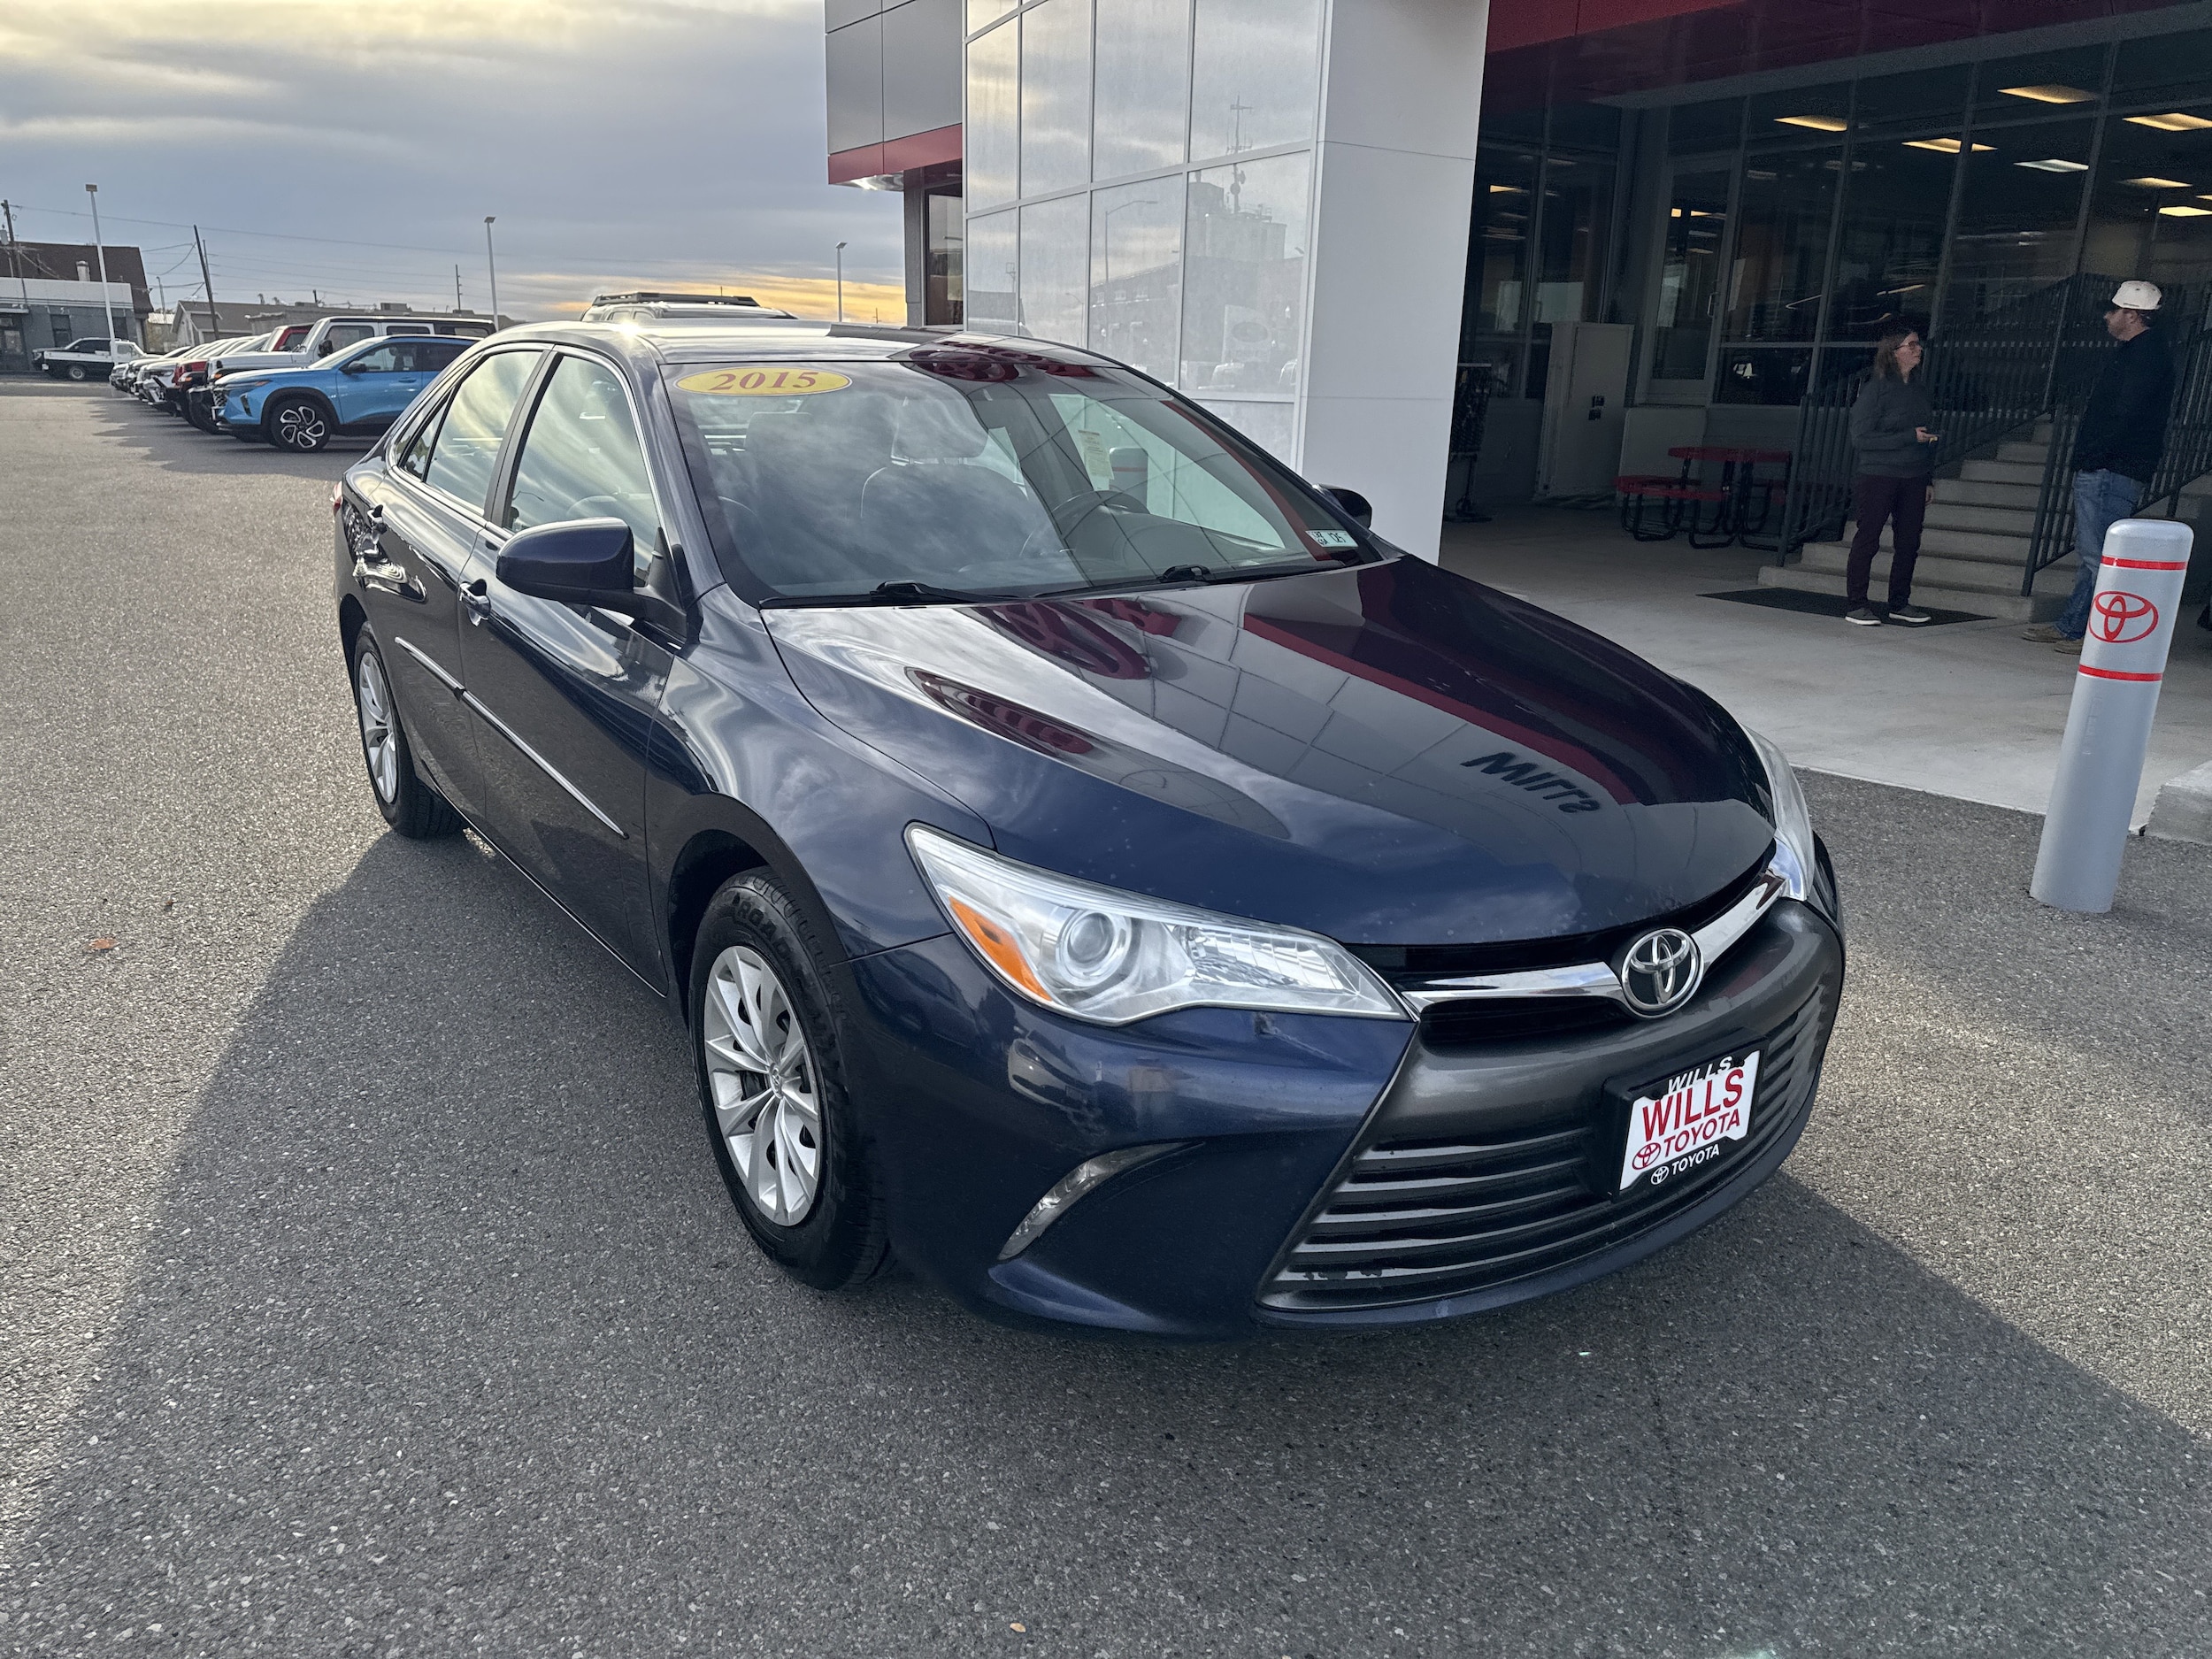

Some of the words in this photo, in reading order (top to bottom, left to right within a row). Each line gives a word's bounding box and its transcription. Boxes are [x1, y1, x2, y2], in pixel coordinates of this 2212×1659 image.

[708, 372, 819, 391] 2015
[1668, 1056, 1733, 1094] WILLS
[1642, 1069, 1744, 1141] WILLS
[1664, 1108, 1740, 1157] TOYOTA
[1672, 1144, 1720, 1175] TOYOTA
